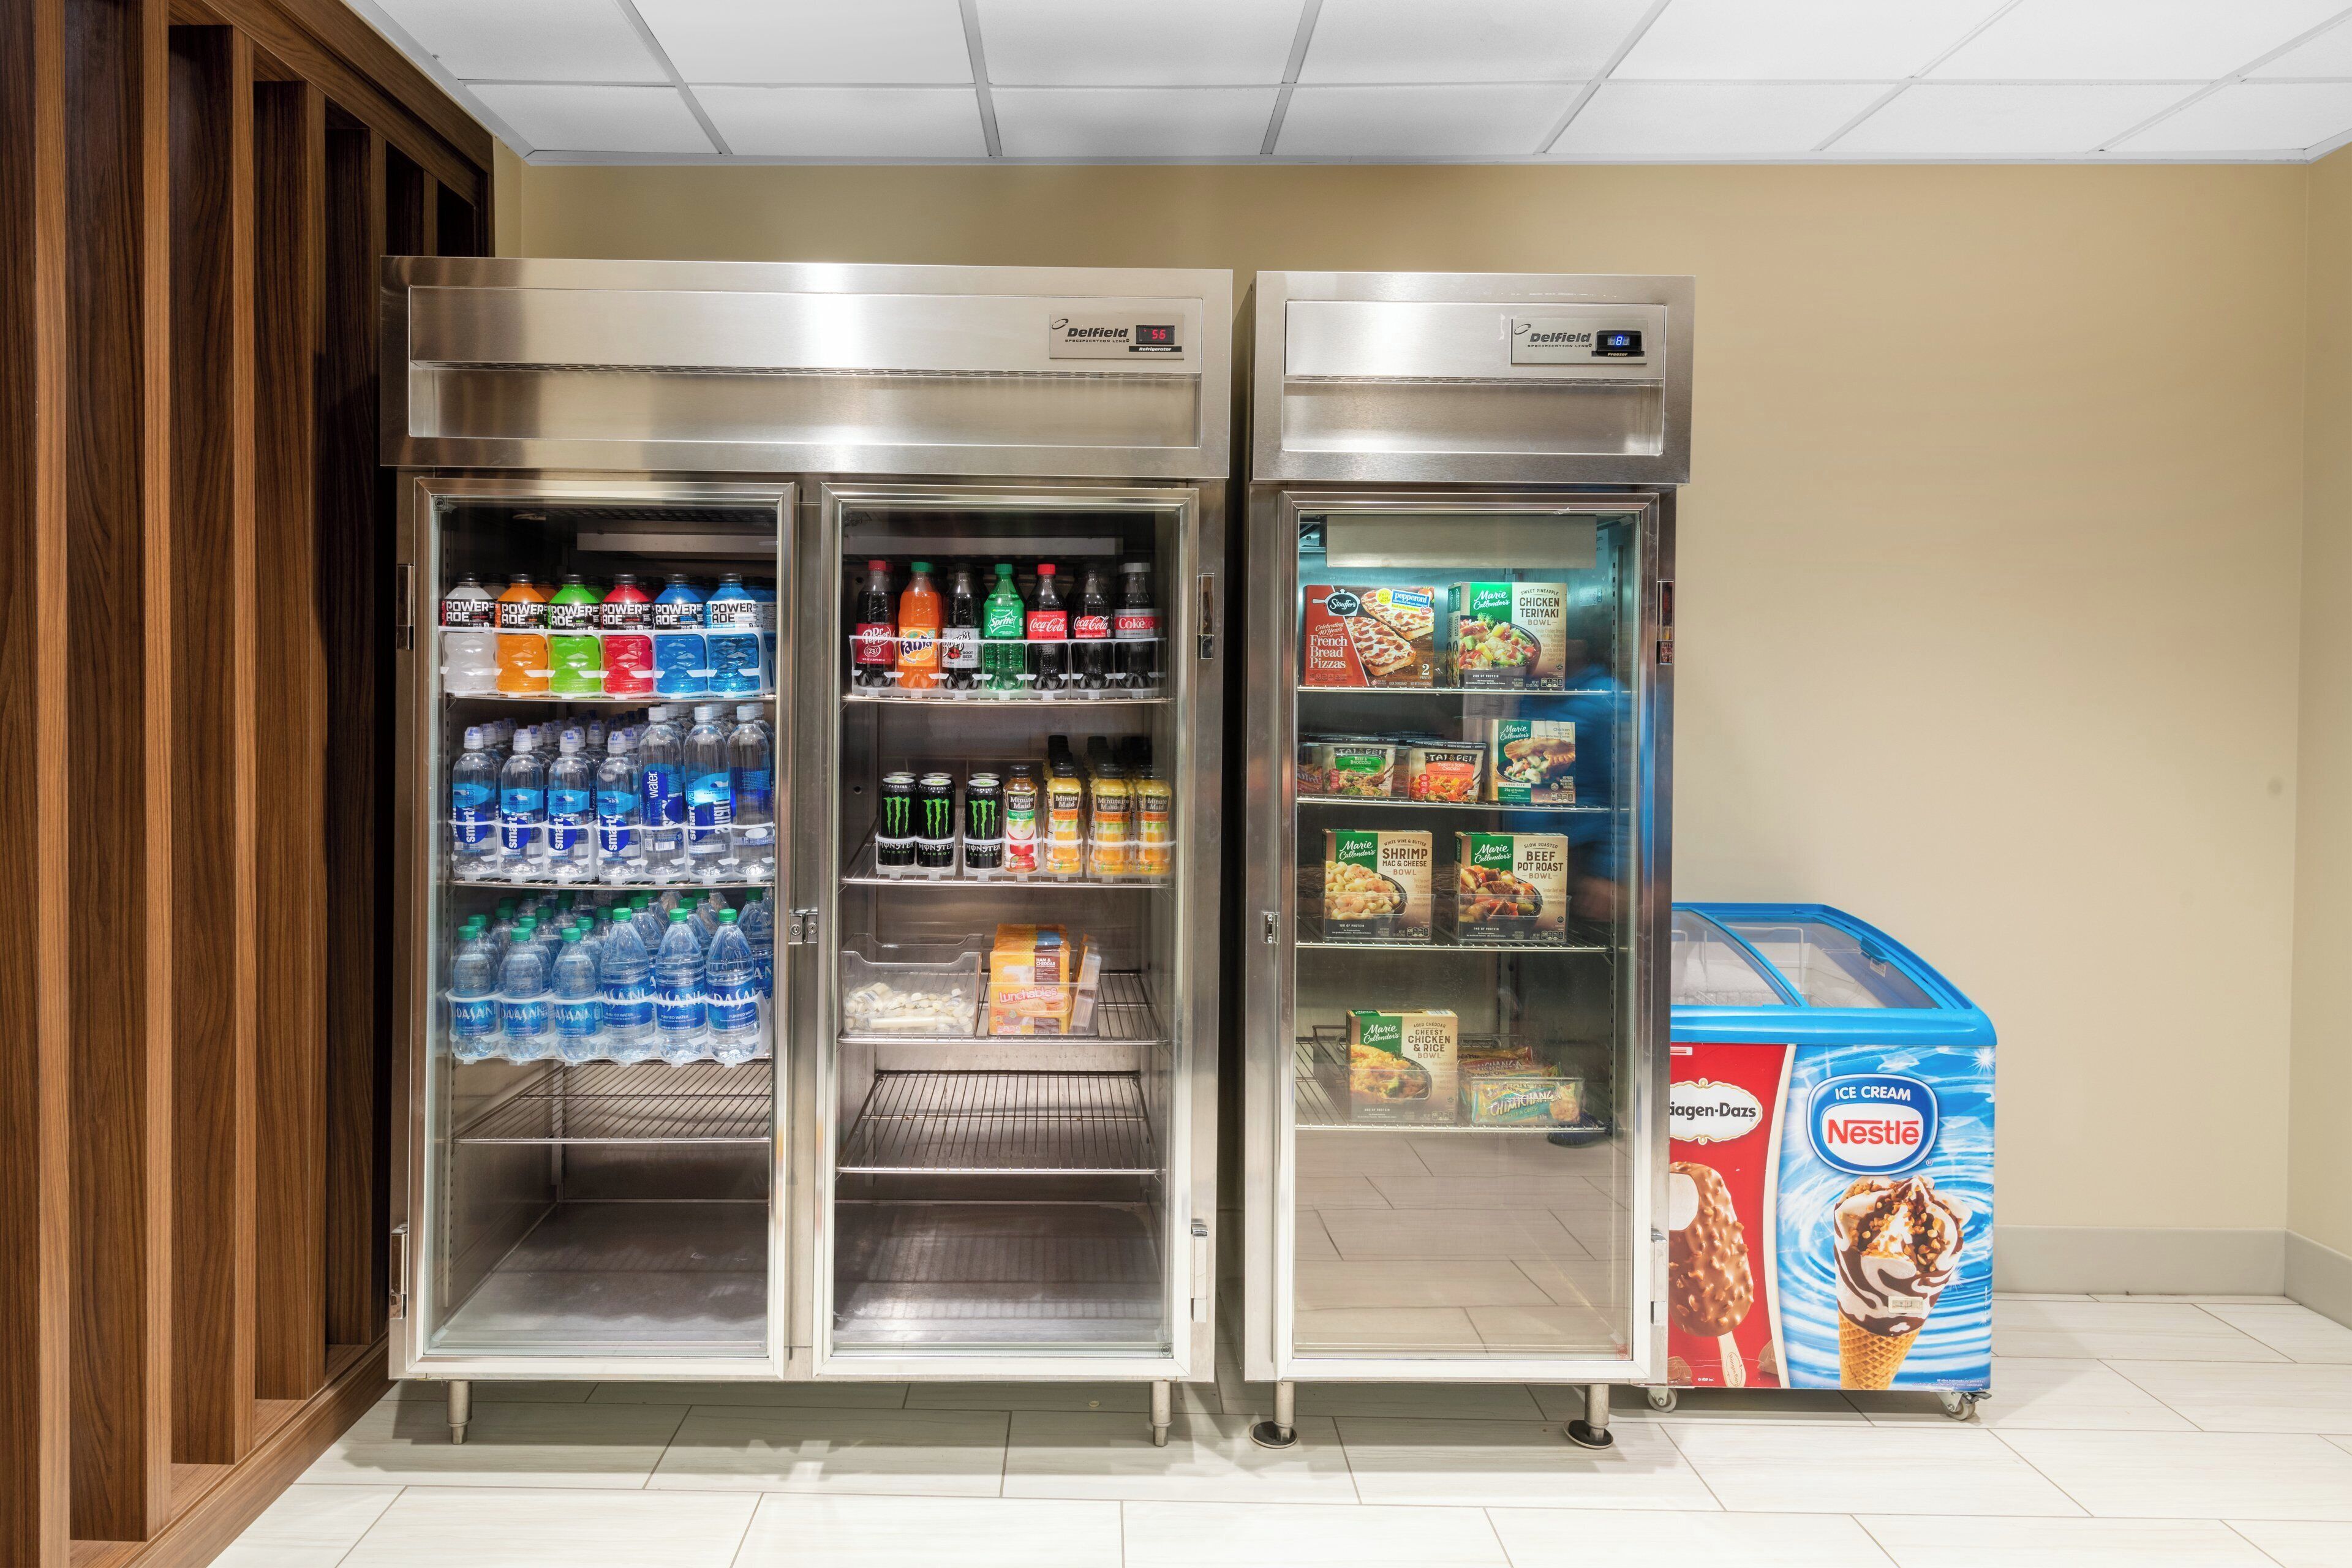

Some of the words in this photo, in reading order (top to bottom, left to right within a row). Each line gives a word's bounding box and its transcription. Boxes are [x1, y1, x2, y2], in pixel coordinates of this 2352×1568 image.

[1067, 328, 1129, 337] Delfield
[1152, 329, 1166, 339] 56
[1529, 333, 1592, 342] Delfield
[1394, 592, 1427, 603] pepperoni
[1474, 590, 1508, 603] Marie
[1519, 597, 1560, 607] CHICKEN
[446, 601, 489, 612] POWER
[502, 603, 544, 615] POWER
[602, 603, 643, 615] POWER
[712, 603, 753, 613] POWER
[1330, 598, 1356, 609] Stouffer's
[1473, 599, 1510, 610] Callender's
[551, 605, 593, 616] POWER
[655, 604, 697, 615] POWER
[1520, 608, 1559, 618] TERIYAKI
[446, 612, 470, 622] ADE
[502, 614, 526, 625] ADE
[551, 616, 573, 627] ADE
[602, 614, 623, 625] ADE
[655, 614, 678, 625] ADE
[712, 613, 736, 623] ADE
[990, 617, 1014, 627] Sprite
[1030, 618, 1065, 632] Coca-Cola
[1074, 616, 1109, 630] Coca-Cola
[1118, 618, 1145, 629] Coke
[1315, 622, 1344, 631] Celebrating
[900, 635, 932, 657] Fanta
[1310, 635, 1348, 646] French
[1310, 646, 1343, 657] Bread
[1310, 657, 1346, 669] Pizzas
[1422, 663, 1430, 676] 2
[1500, 725, 1528, 734] Marie
[1499, 732, 1530, 741] Callender's
[464, 810, 476, 843] smart
[688, 805, 696, 840] smart
[507, 816, 518, 848] smart
[554, 818, 564, 850] smart
[606, 819, 617, 851] smart
[879, 842, 914, 850] MONSTER
[919, 842, 954, 852] MONSTER
[966, 843, 1001, 853] MONSTER
[1340, 840, 1373, 851] Marie
[1474, 844, 1509, 856] Marie
[1339, 850, 1375, 860] Callender's
[1382, 848, 1428, 860] SHRIMP
[1474, 853, 1511, 864] Callender's
[1526, 851, 1556, 861] BEEF
[1517, 862, 1534, 872] POT
[1536, 862, 1564, 872] ROAST
[998, 986, 1058, 1004] Lunchables
[657, 990, 701, 1012] ASANI
[1363, 1024, 1397, 1036] Marie
[1363, 1033, 1400, 1044] Callender's
[1834, 1088, 1856, 1101] ICE
[1860, 1085, 1911, 1101] CREAM
[1670, 1101, 1757, 1121] agen-Dazs
[1826, 1118, 1920, 1145] Nestlé
